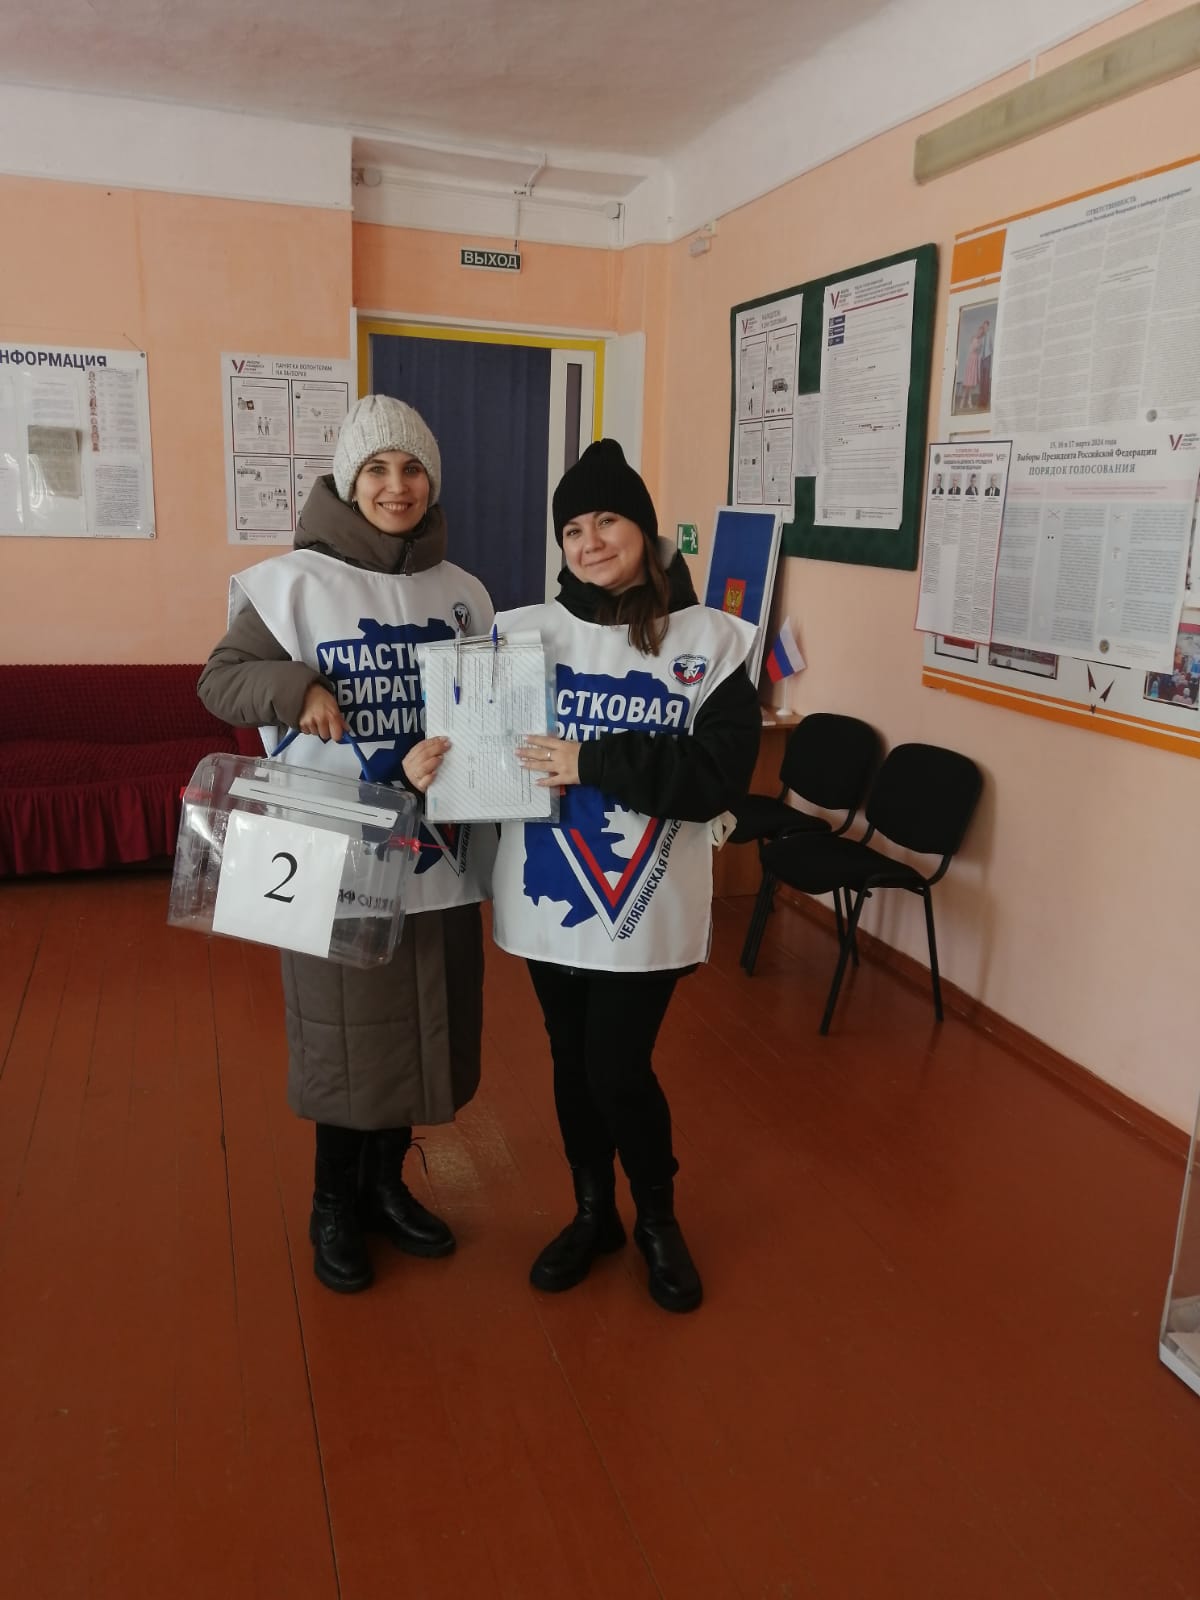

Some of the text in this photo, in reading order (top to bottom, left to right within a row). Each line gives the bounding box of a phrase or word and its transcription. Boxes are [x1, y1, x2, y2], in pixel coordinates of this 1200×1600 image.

[464, 251, 518, 269] ВЫХОД
[0, 349, 107, 371] НФОРМАЦИЯ
[1017, 453, 1040, 463] Выборы
[1041, 452, 1077, 462] Президента
[1077, 449, 1113, 459] Российской
[1115, 448, 1157, 460] Федерации
[1029, 463, 1136, 476] ПОРЯДОК ГОЛОСОВАНИЯ
[331, 675, 418, 706] БИРАТ
[557, 689, 683, 728] СТКОВАЯ
[263, 851, 298, 904] 2
[617, 858, 668, 940] ЧЕЛЯБИНСКАЯ
